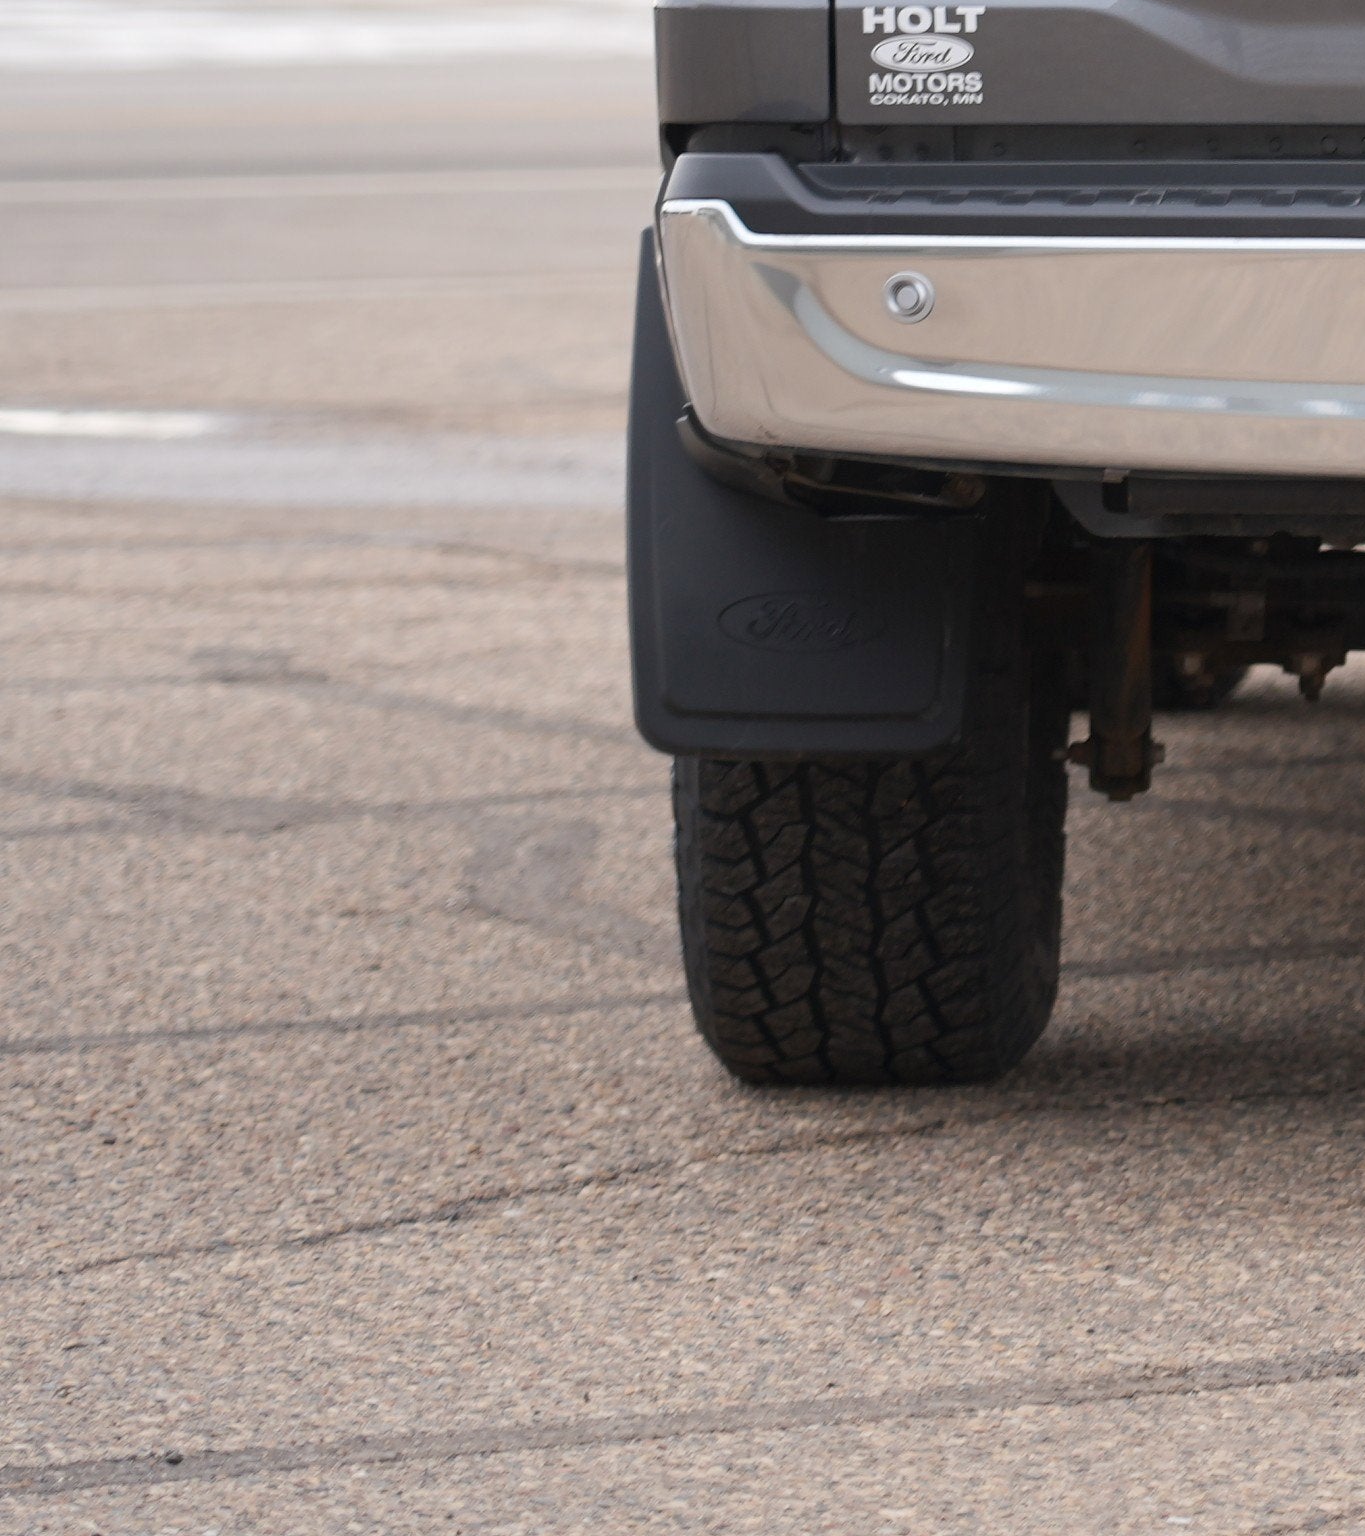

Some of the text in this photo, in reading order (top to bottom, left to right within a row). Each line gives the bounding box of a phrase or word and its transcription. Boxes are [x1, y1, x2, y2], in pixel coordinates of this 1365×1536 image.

[862, 5, 987, 34] HOLT
[892, 41, 952, 65] Ford
[868, 72, 983, 93] MOTORS
[869, 93, 984, 107] COKATO, MN
